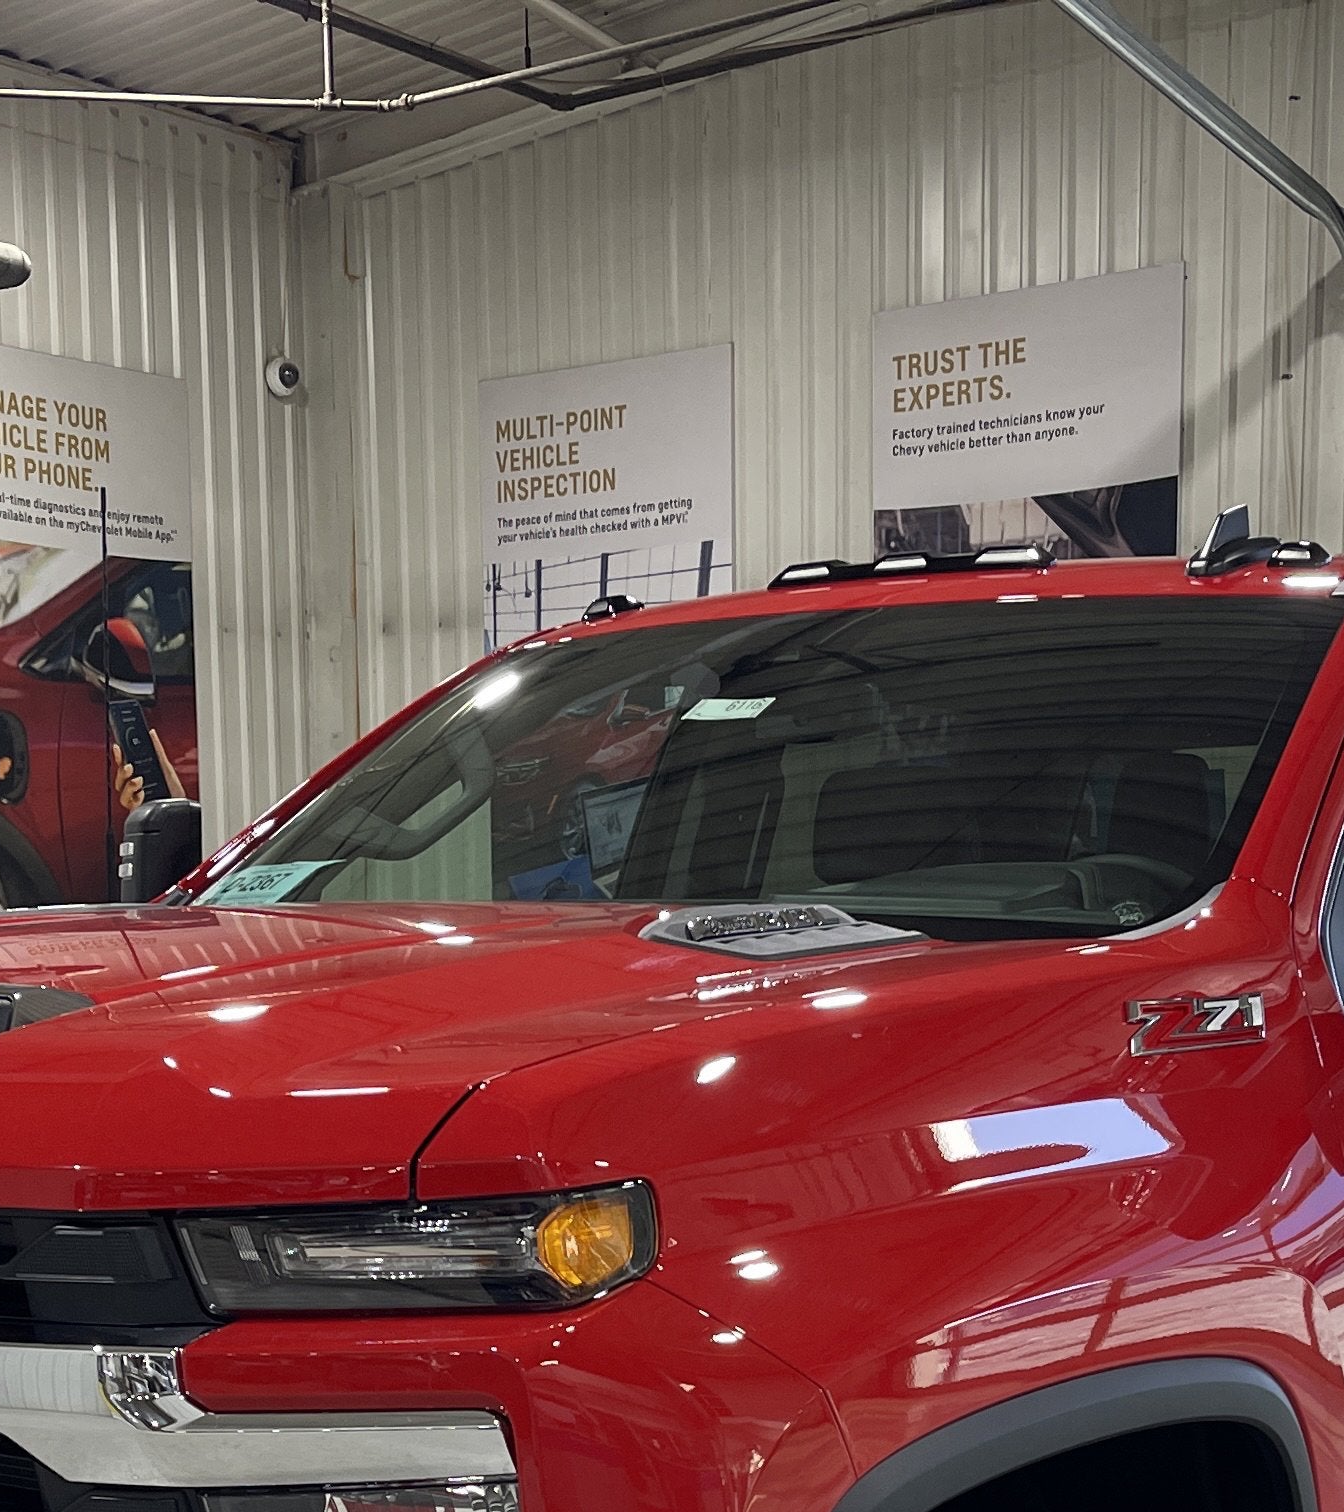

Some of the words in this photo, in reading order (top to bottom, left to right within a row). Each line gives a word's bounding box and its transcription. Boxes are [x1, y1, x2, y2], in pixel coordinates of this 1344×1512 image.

[892, 345, 971, 380] TRUST
[978, 337, 1026, 368] THE
[892, 375, 1011, 413] EXPERTS.
[53, 400, 108, 432] YOUR
[495, 404, 627, 443] MULTI-POINT
[892, 424, 934, 441] Factory
[936, 420, 975, 436] trained
[978, 411, 1043, 431] technicians
[1045, 406, 1076, 422] know
[1078, 403, 1105, 420] your
[55, 432, 111, 464] FROM
[496, 442, 580, 474] VEHICLE
[892, 442, 926, 457] Chevy
[928, 438, 966, 453] vehicle
[968, 434, 1003, 448] better
[1006, 430, 1032, 444] than
[1034, 424, 1078, 441] anyone.
[24, 457, 99, 492] PHONE.
[497, 468, 616, 504] INSPECTION
[33, 498, 86, 518] diagnostics
[107, 510, 130, 525] enjoy
[132, 514, 164, 526] remote
[35, 515, 46, 526] on
[49, 516, 64, 529] the
[66, 518, 123, 536] myChevolet
[125, 526, 153, 540] Mobile
[155, 529, 178, 544] App.
[497, 517, 513, 529] The
[515, 516, 541, 530] peace
[543, 512, 553, 524] of
[555, 509, 577, 523] mind
[579, 507, 599, 520] that
[601, 506, 630, 518] comes
[633, 502, 655, 515] from
[658, 498, 693, 513] getting
[497, 533, 517, 546] your
[519, 527, 557, 542] vehicle's
[559, 523, 588, 538] health
[590, 520, 628, 535] checked
[630, 517, 651, 530] with
[653, 517, 659, 527] a
[661, 510, 689, 526] MPVI.
[1125, 992, 1266, 1057] Z71
